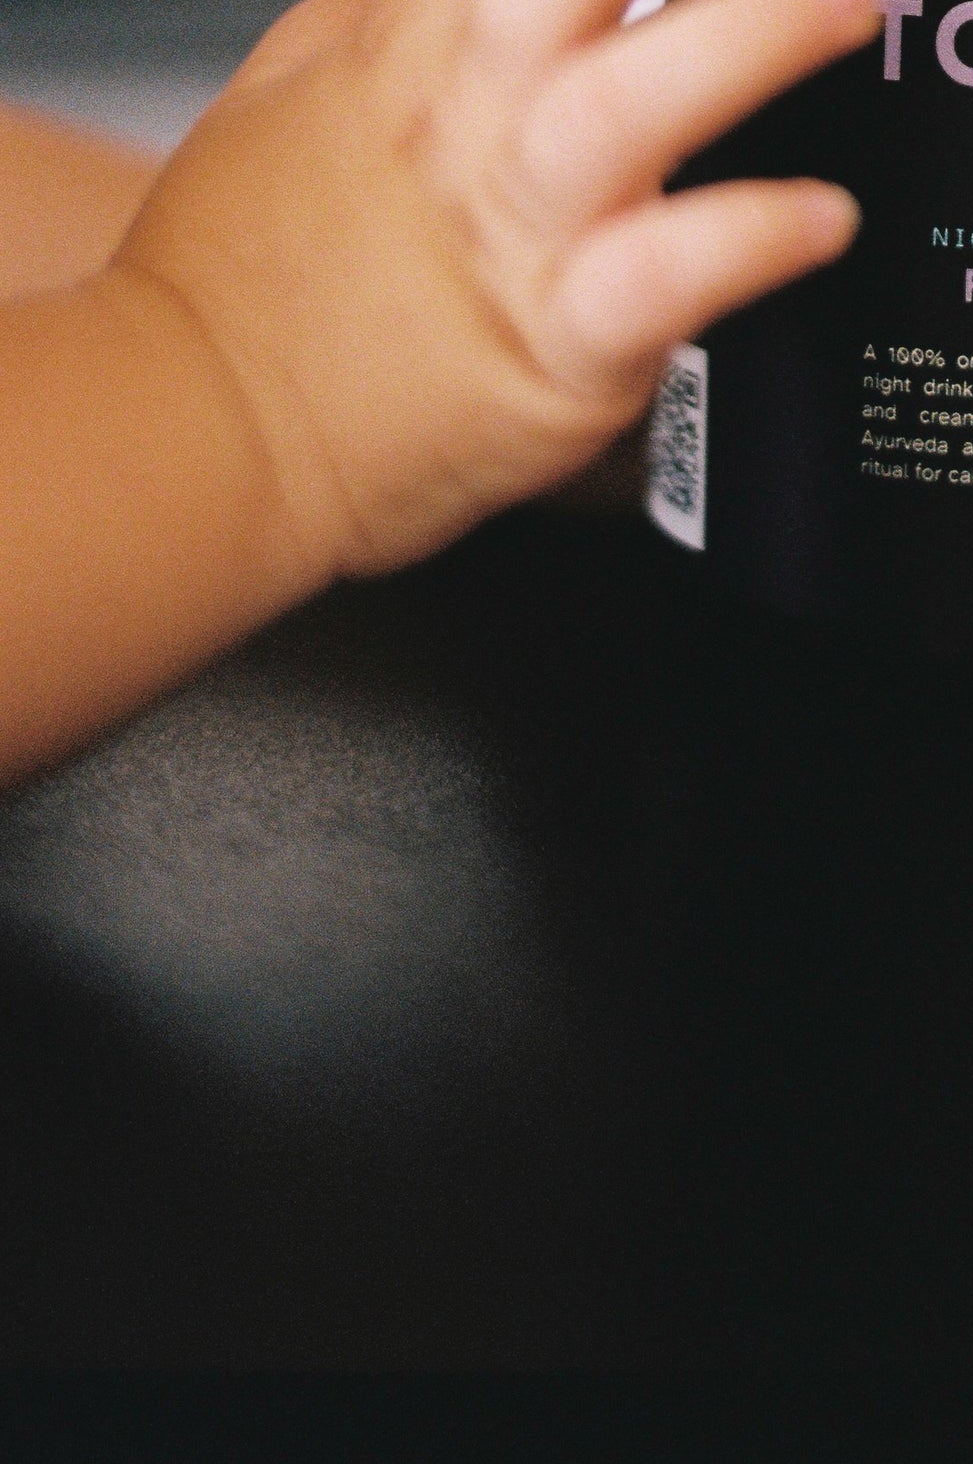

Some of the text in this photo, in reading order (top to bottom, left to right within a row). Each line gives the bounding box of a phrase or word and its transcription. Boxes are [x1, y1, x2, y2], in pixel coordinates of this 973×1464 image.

[863, 343, 877, 361] A
[888, 346, 946, 367] 100%
[863, 372, 911, 396] night
[923, 378, 973, 398] drink
[862, 403, 897, 420] and
[861, 429, 949, 453] Ayurveda
[861, 458, 908, 479] ritual
[915, 462, 942, 482] for
